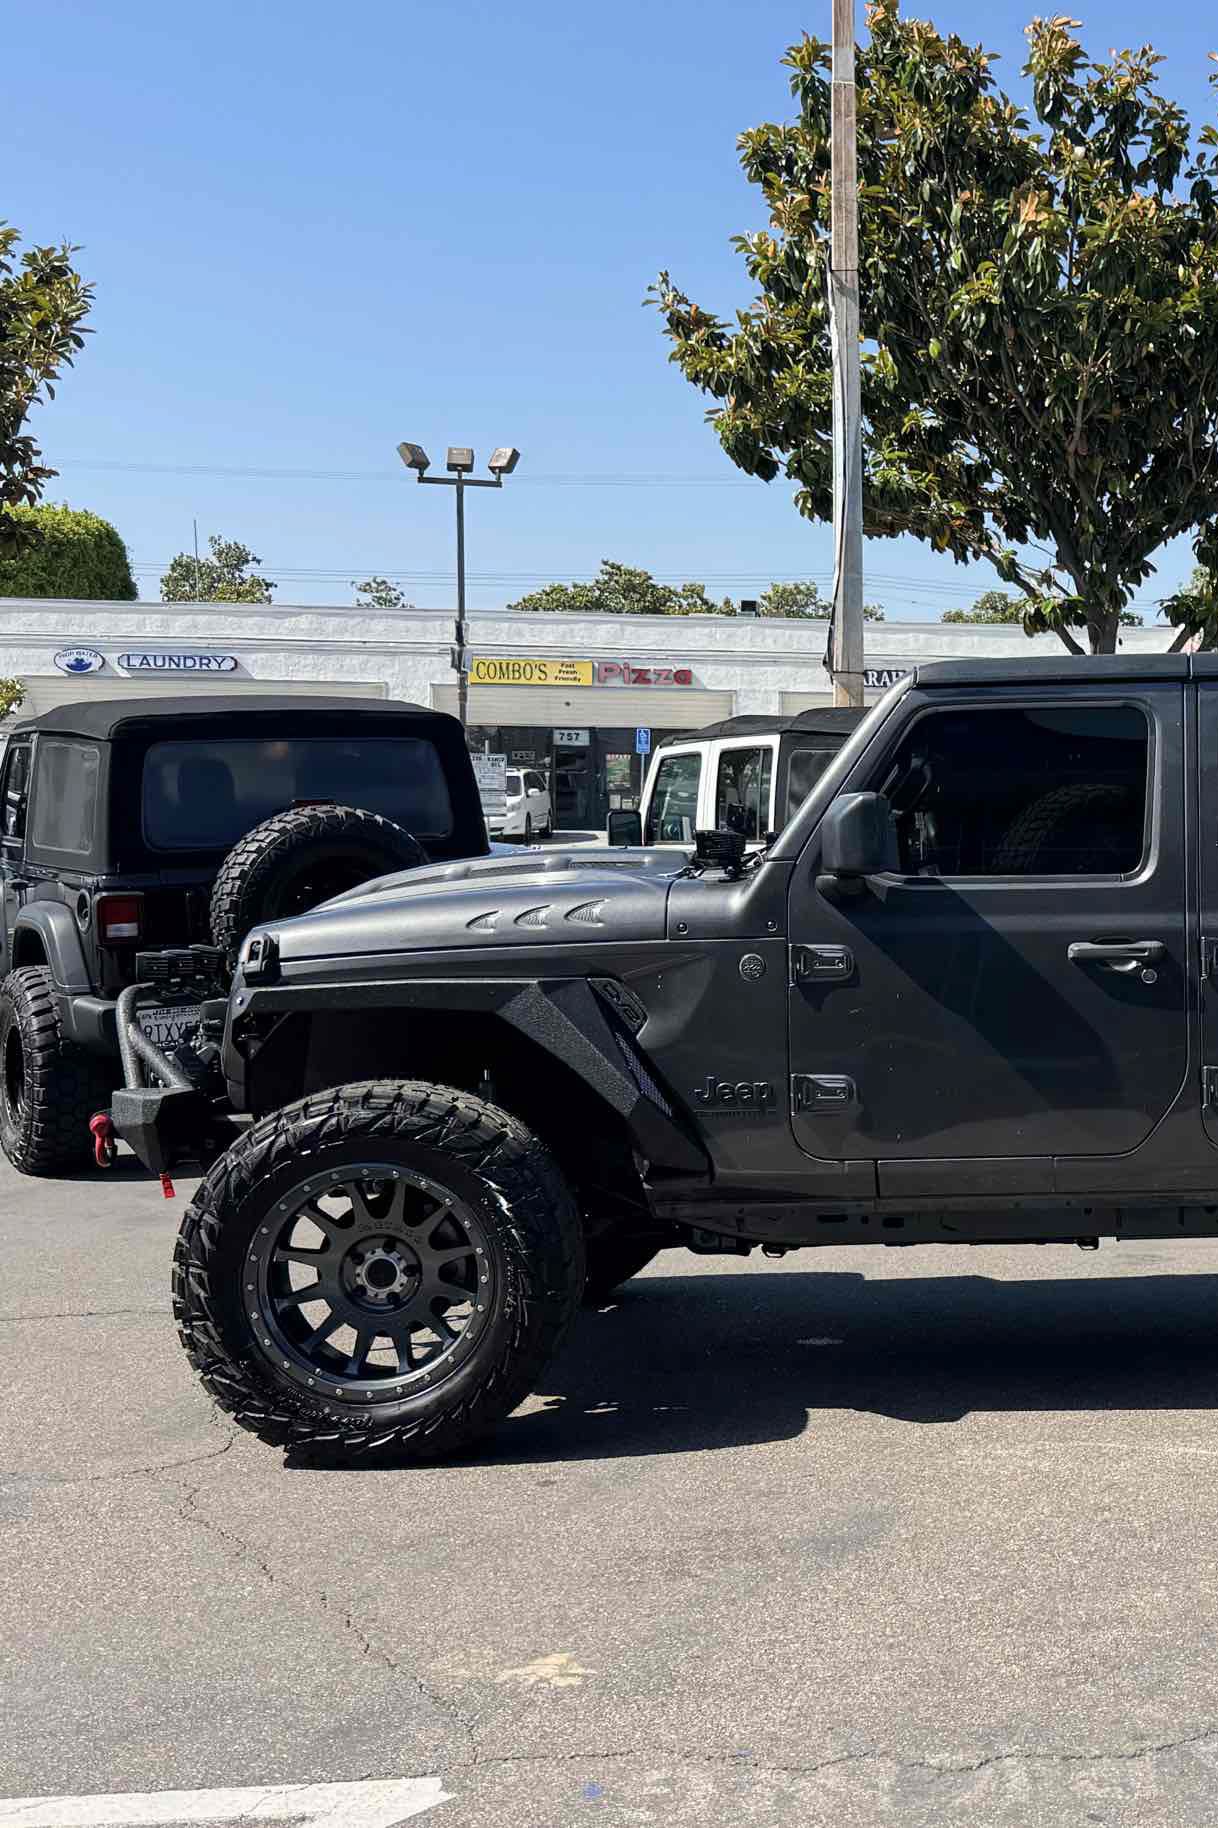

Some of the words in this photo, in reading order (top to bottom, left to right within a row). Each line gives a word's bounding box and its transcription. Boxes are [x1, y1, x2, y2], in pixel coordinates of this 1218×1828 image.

[127, 655, 226, 669] LAUNDRY
[476, 661, 548, 682] COMBO'S
[597, 662, 693, 685] Pizza
[559, 732, 580, 741] 757
[693, 1076, 773, 1104] Jeep
